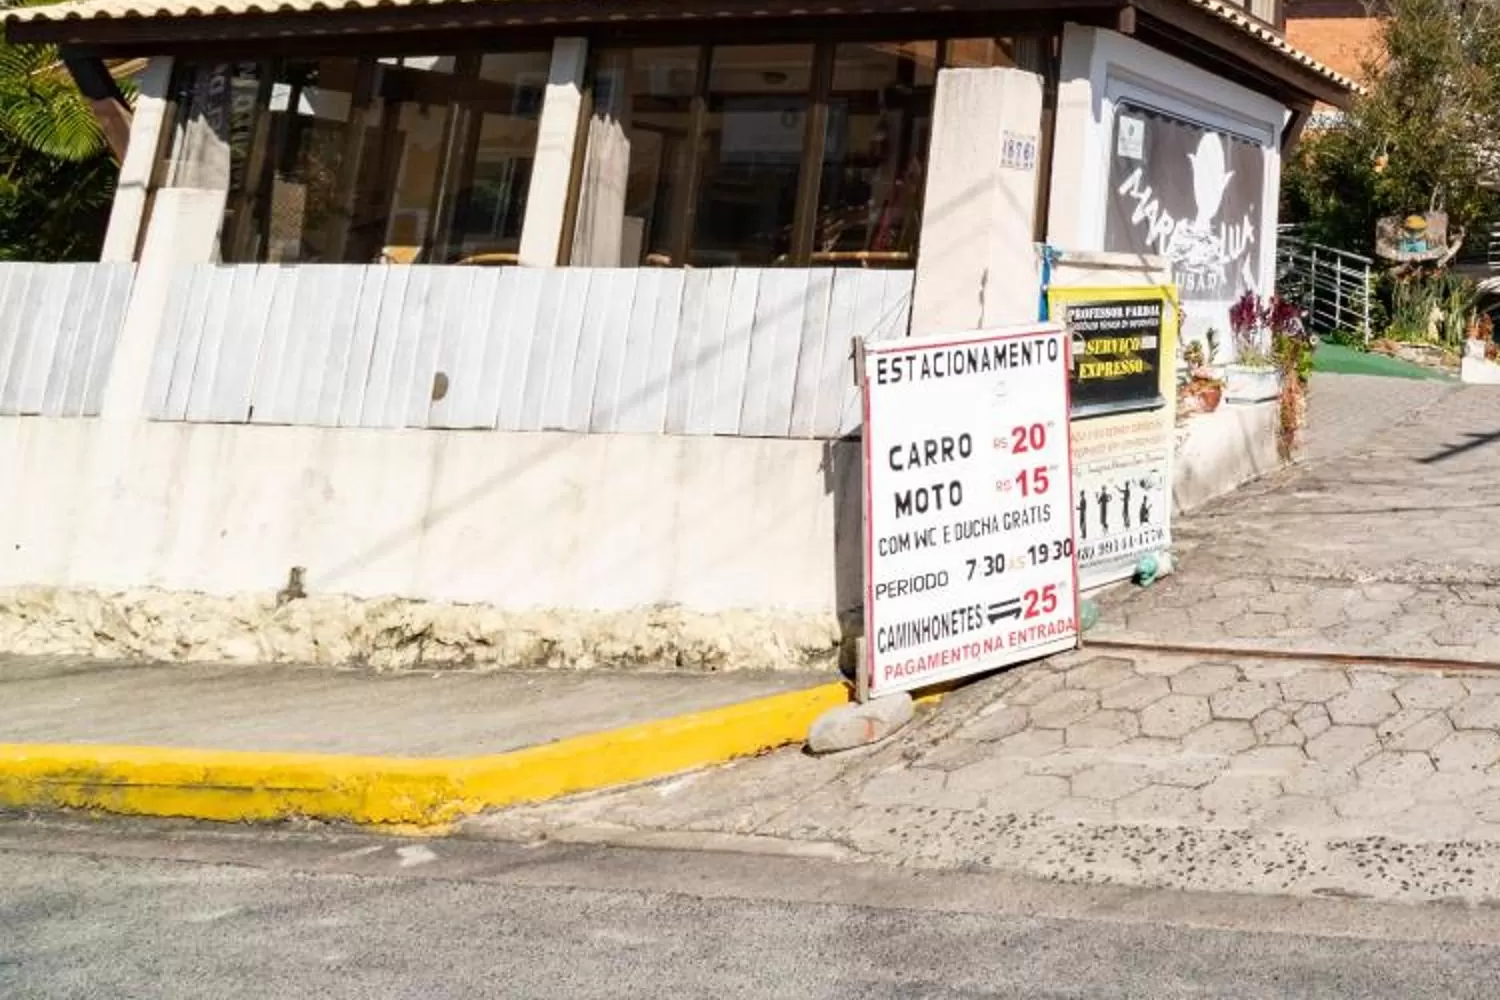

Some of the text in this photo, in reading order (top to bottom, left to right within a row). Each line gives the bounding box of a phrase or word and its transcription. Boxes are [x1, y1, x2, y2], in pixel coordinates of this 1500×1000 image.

[876, 337, 1059, 385] ESTACIONAMENTO
[1079, 359, 1144, 379] EXPRESSO
[888, 432, 973, 472] CARRO
[1011, 422, 1046, 455] 20
[893, 479, 963, 519] MOTO
[1015, 465, 1050, 498] 15
[878, 531, 911, 557] COM
[913, 526, 938, 549] WC
[942, 524, 952, 544] E
[954, 512, 1001, 542] DUCHA
[875, 570, 950, 600] PERIODO
[877, 583, 1058, 655] CAMINHONETES 25
[883, 616, 1077, 682] PAGAMENTO NA ENTRADA
